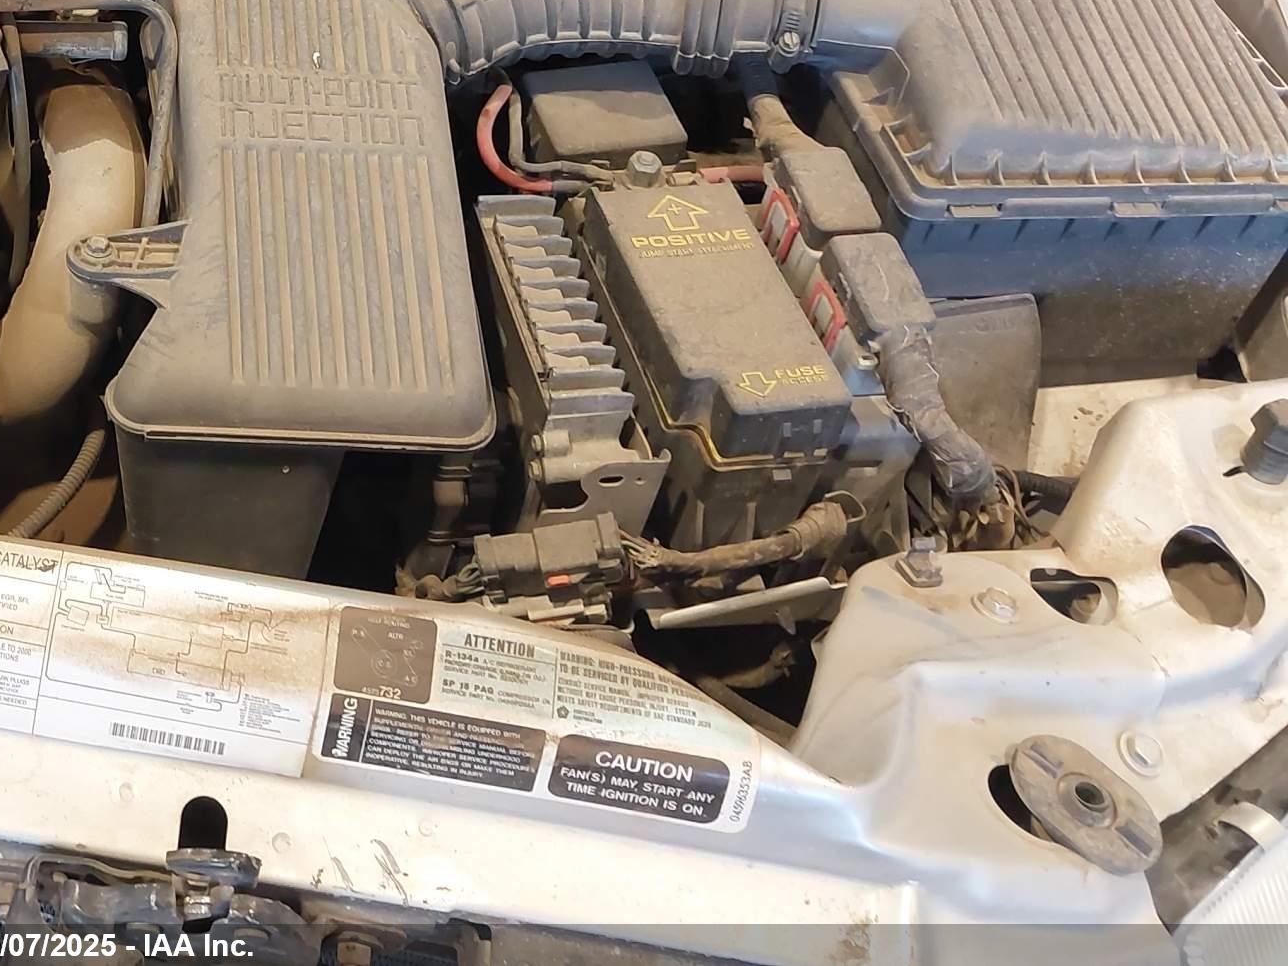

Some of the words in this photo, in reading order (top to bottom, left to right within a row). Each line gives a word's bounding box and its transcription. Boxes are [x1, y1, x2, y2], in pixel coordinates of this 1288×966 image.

[220, 107, 426, 146] INJECTION
[631, 229, 752, 248] POSITIVE
[775, 365, 825, 379] FUSE
[7, 645, 16, 653] TO
[445, 650, 479, 661] R-134a
[465, 634, 534, 656] ATTENTION
[332, 697, 358, 756] WARNING
[466, 725, 502, 735] EQUIPPED
[595, 750, 693, 782] CAUTION
[560, 766, 606, 784] FAN(S)
[643, 782, 682, 798] START
[687, 790, 715, 804] ANY
[565, 781, 597, 795] TIME
[601, 788, 658, 807] IGNITION
[662, 800, 678, 811] IS
